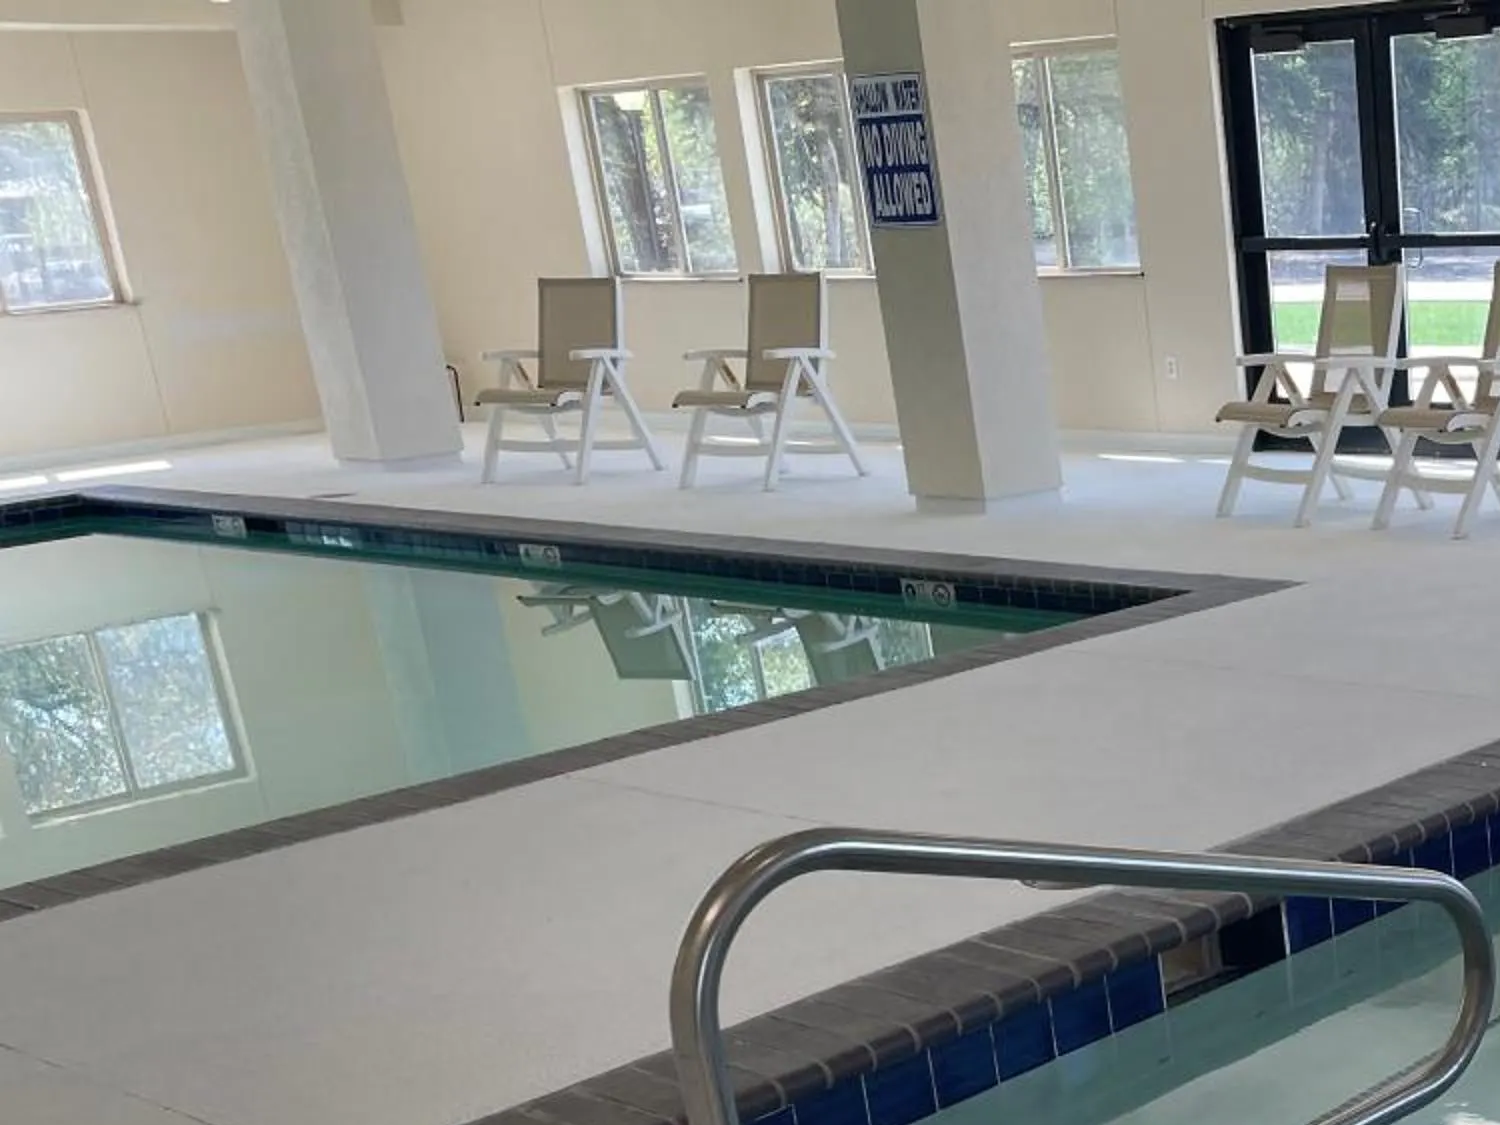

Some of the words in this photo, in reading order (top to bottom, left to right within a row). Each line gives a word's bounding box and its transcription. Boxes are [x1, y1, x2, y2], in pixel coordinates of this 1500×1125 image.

[861, 123, 884, 168] NO
[882, 121, 929, 167] DIVING
[873, 171, 933, 217] ALLOWED
